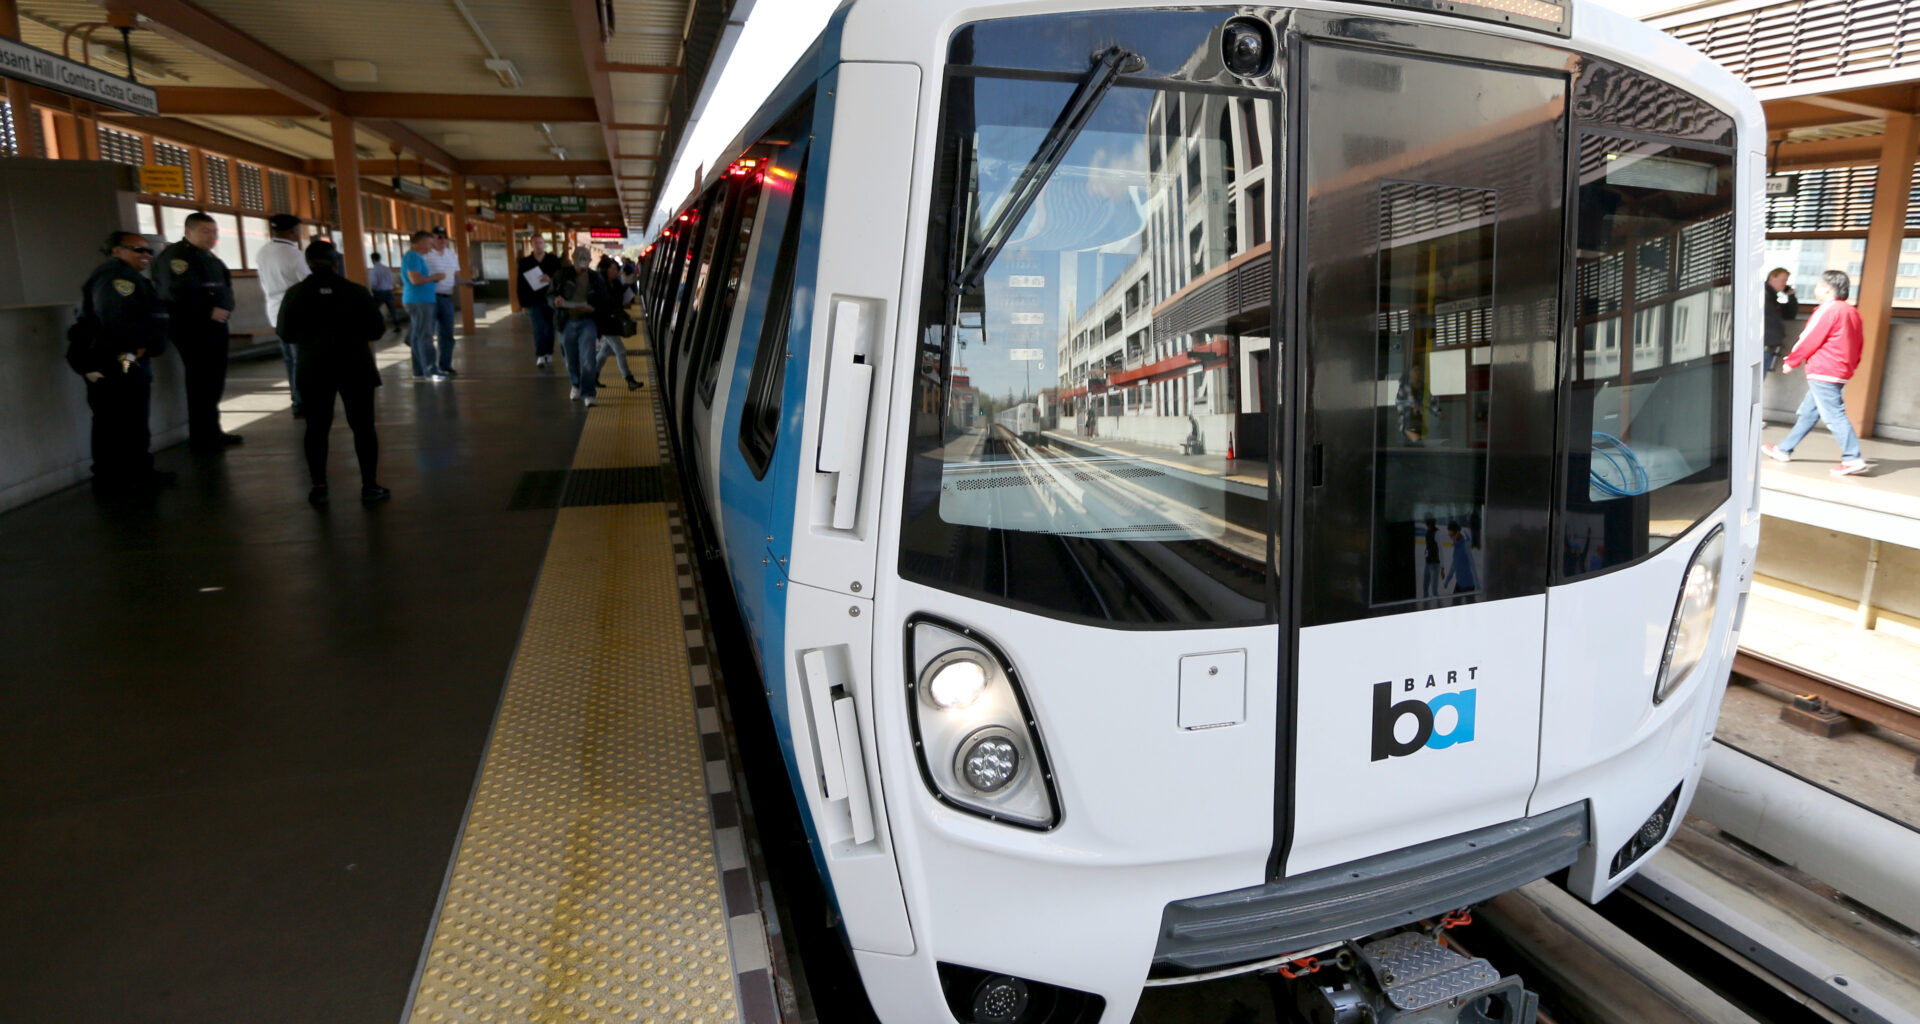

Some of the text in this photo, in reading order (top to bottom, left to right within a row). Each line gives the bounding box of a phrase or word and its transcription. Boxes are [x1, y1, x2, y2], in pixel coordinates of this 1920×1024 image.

[34, 57, 55, 79] Hill
[99, 78, 125, 100] Costa
[126, 87, 155, 110] Centre
[511, 195, 532, 204] EXIT
[532, 203, 553, 212] EXIT
[1405, 666, 1478, 692] BART
[1371, 681, 1477, 762] ba
